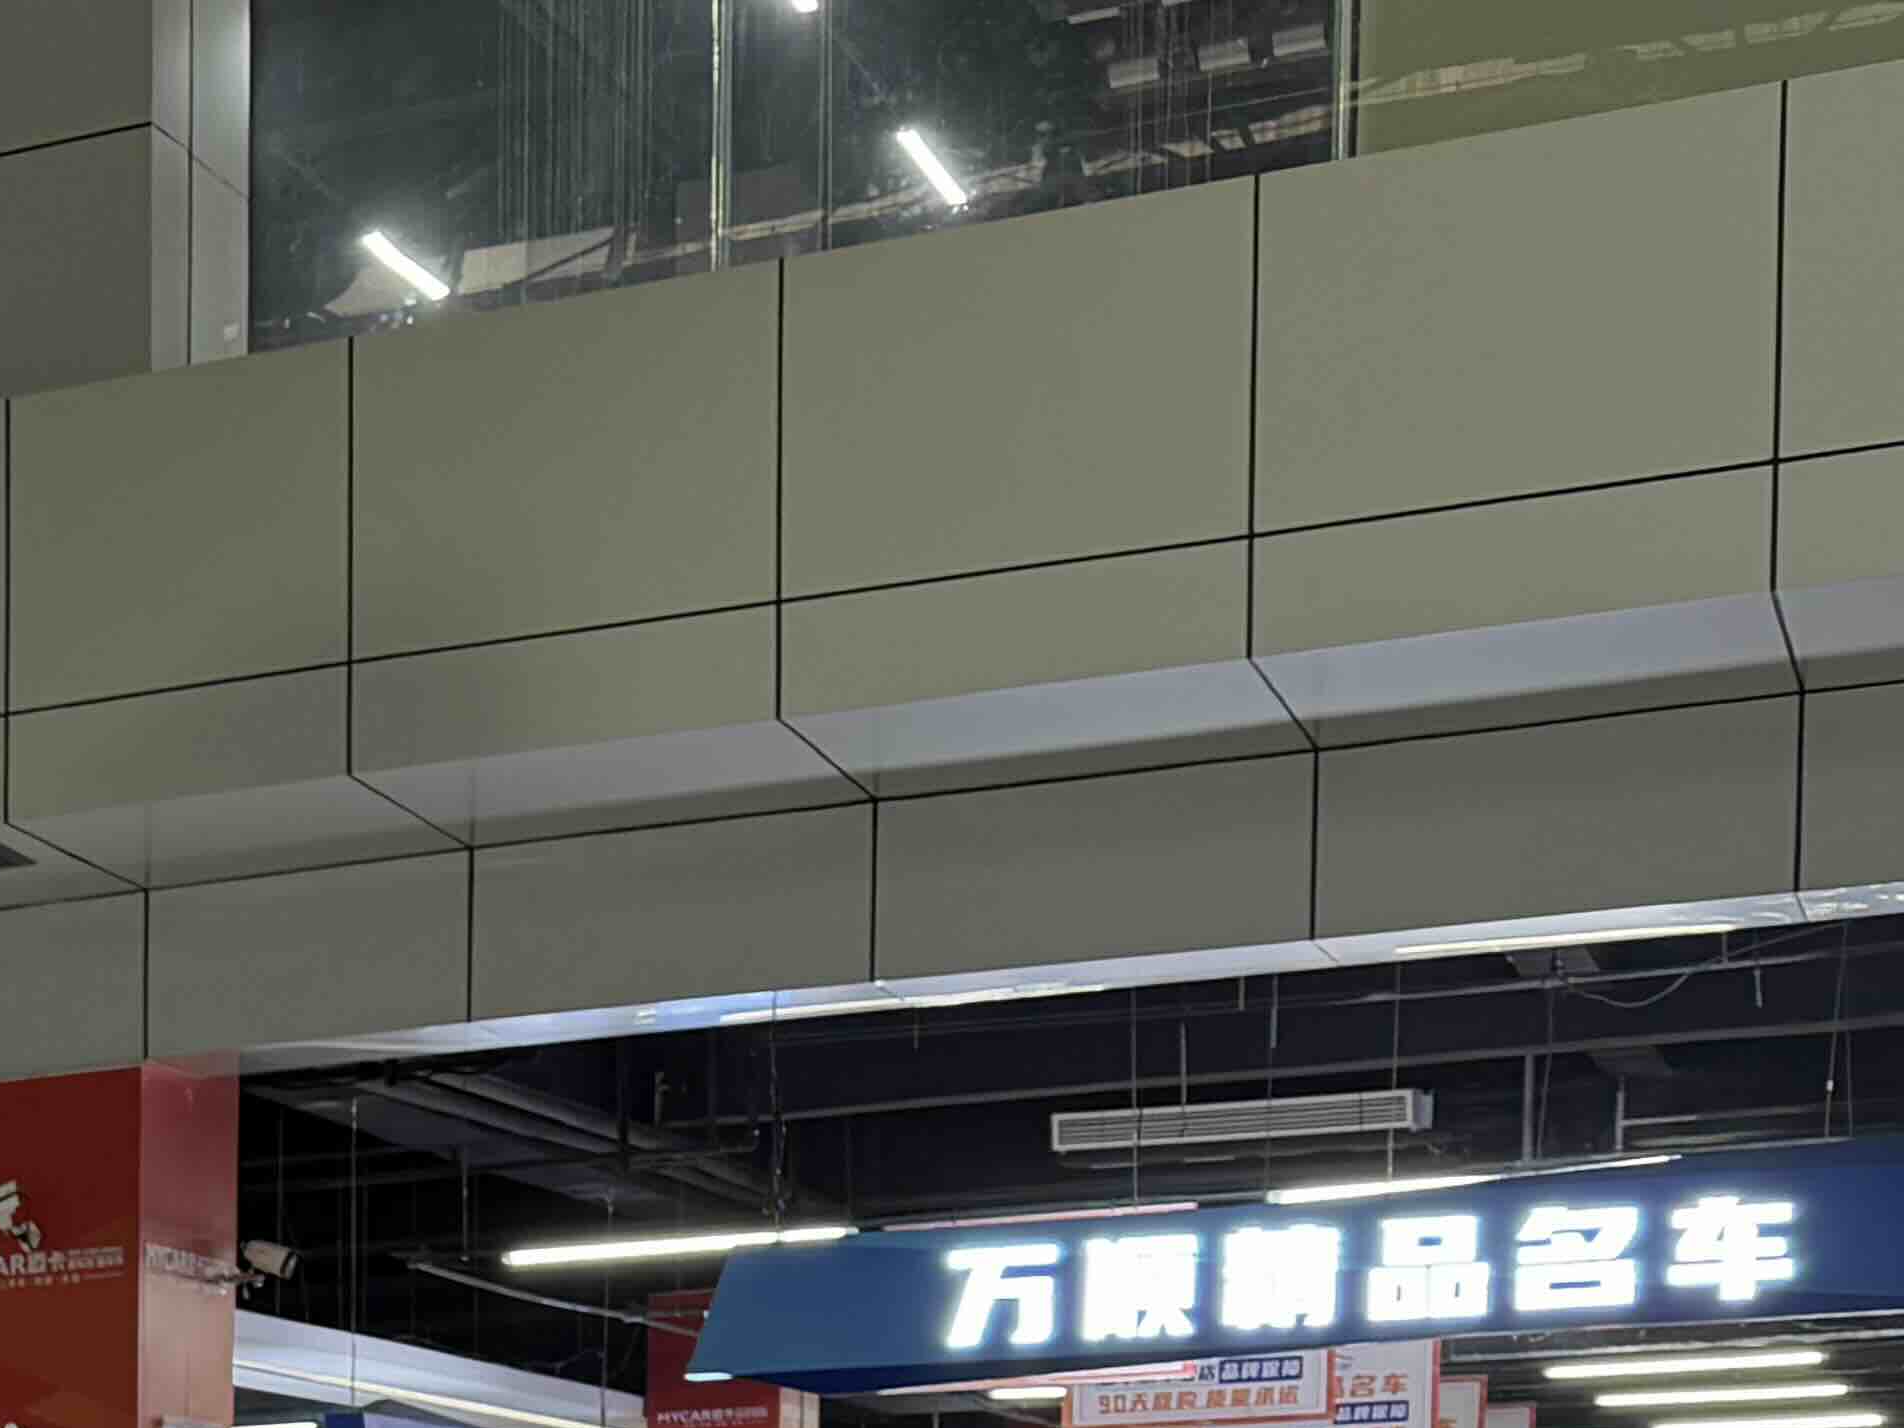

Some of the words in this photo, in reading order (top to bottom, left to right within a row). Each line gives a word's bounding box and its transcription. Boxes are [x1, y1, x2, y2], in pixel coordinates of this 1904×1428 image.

[942, 1195, 1797, 1349] 万顺精品名车
